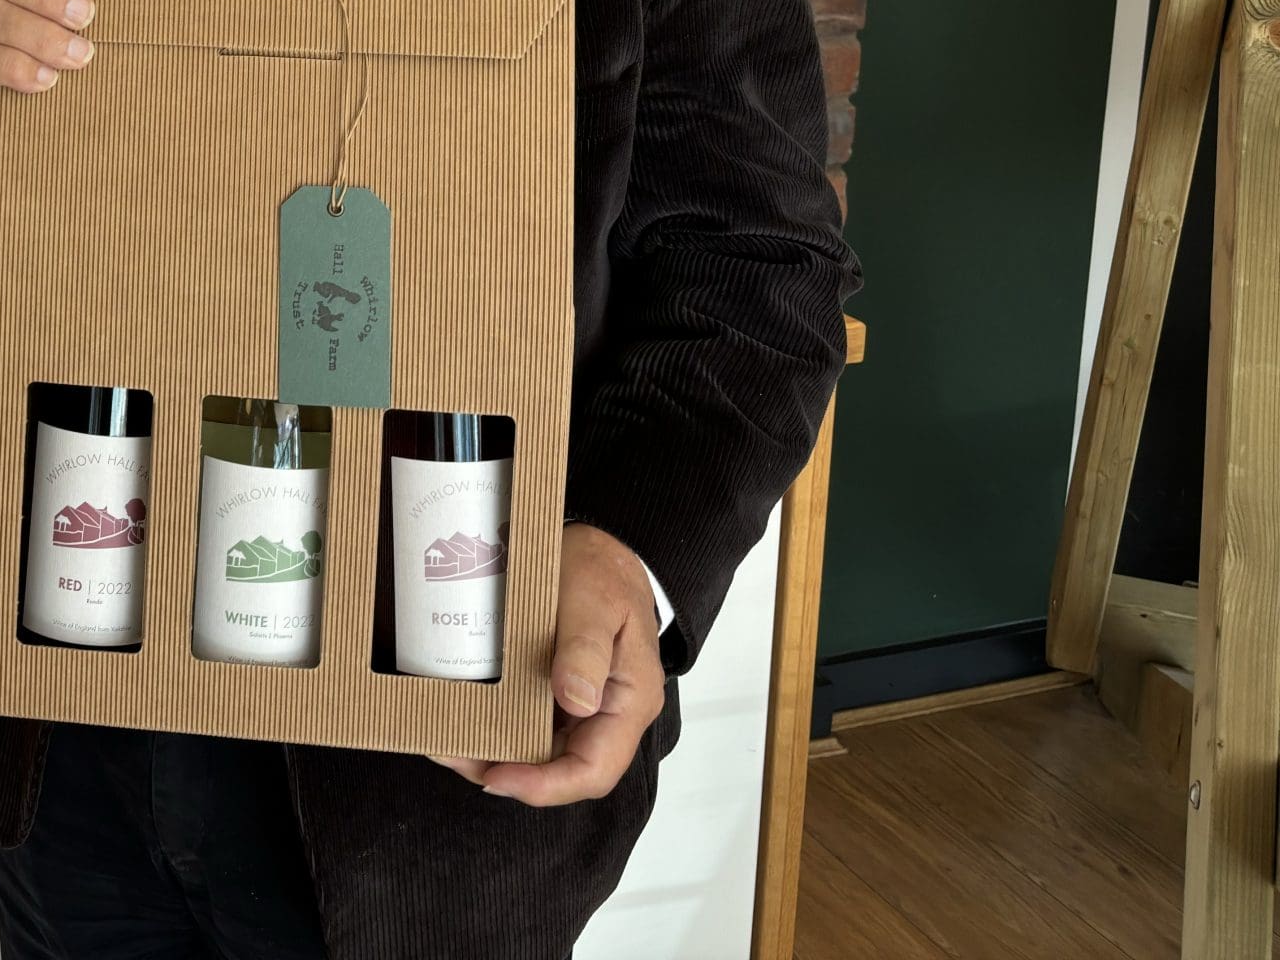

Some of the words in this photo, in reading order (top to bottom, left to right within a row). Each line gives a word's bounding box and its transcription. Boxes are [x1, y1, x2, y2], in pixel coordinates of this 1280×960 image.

[332, 244, 344, 275] Hall
[292, 281, 310, 330] Trust
[358, 276, 379, 342] Whirlow
[328, 338, 340, 372] Farm
[46, 453, 102, 484] WHIRLOW
[107, 454, 135, 472] HALL
[216, 486, 277, 519] WHIRLOW
[283, 487, 310, 504] HALL
[409, 481, 470, 519] WHIRLOW
[58, 576, 82, 592] RED
[97, 582, 132, 595] 2022
[225, 610, 268, 628] WHITE
[282, 614, 316, 629] 2022
[431, 612, 468, 627] ROSE
